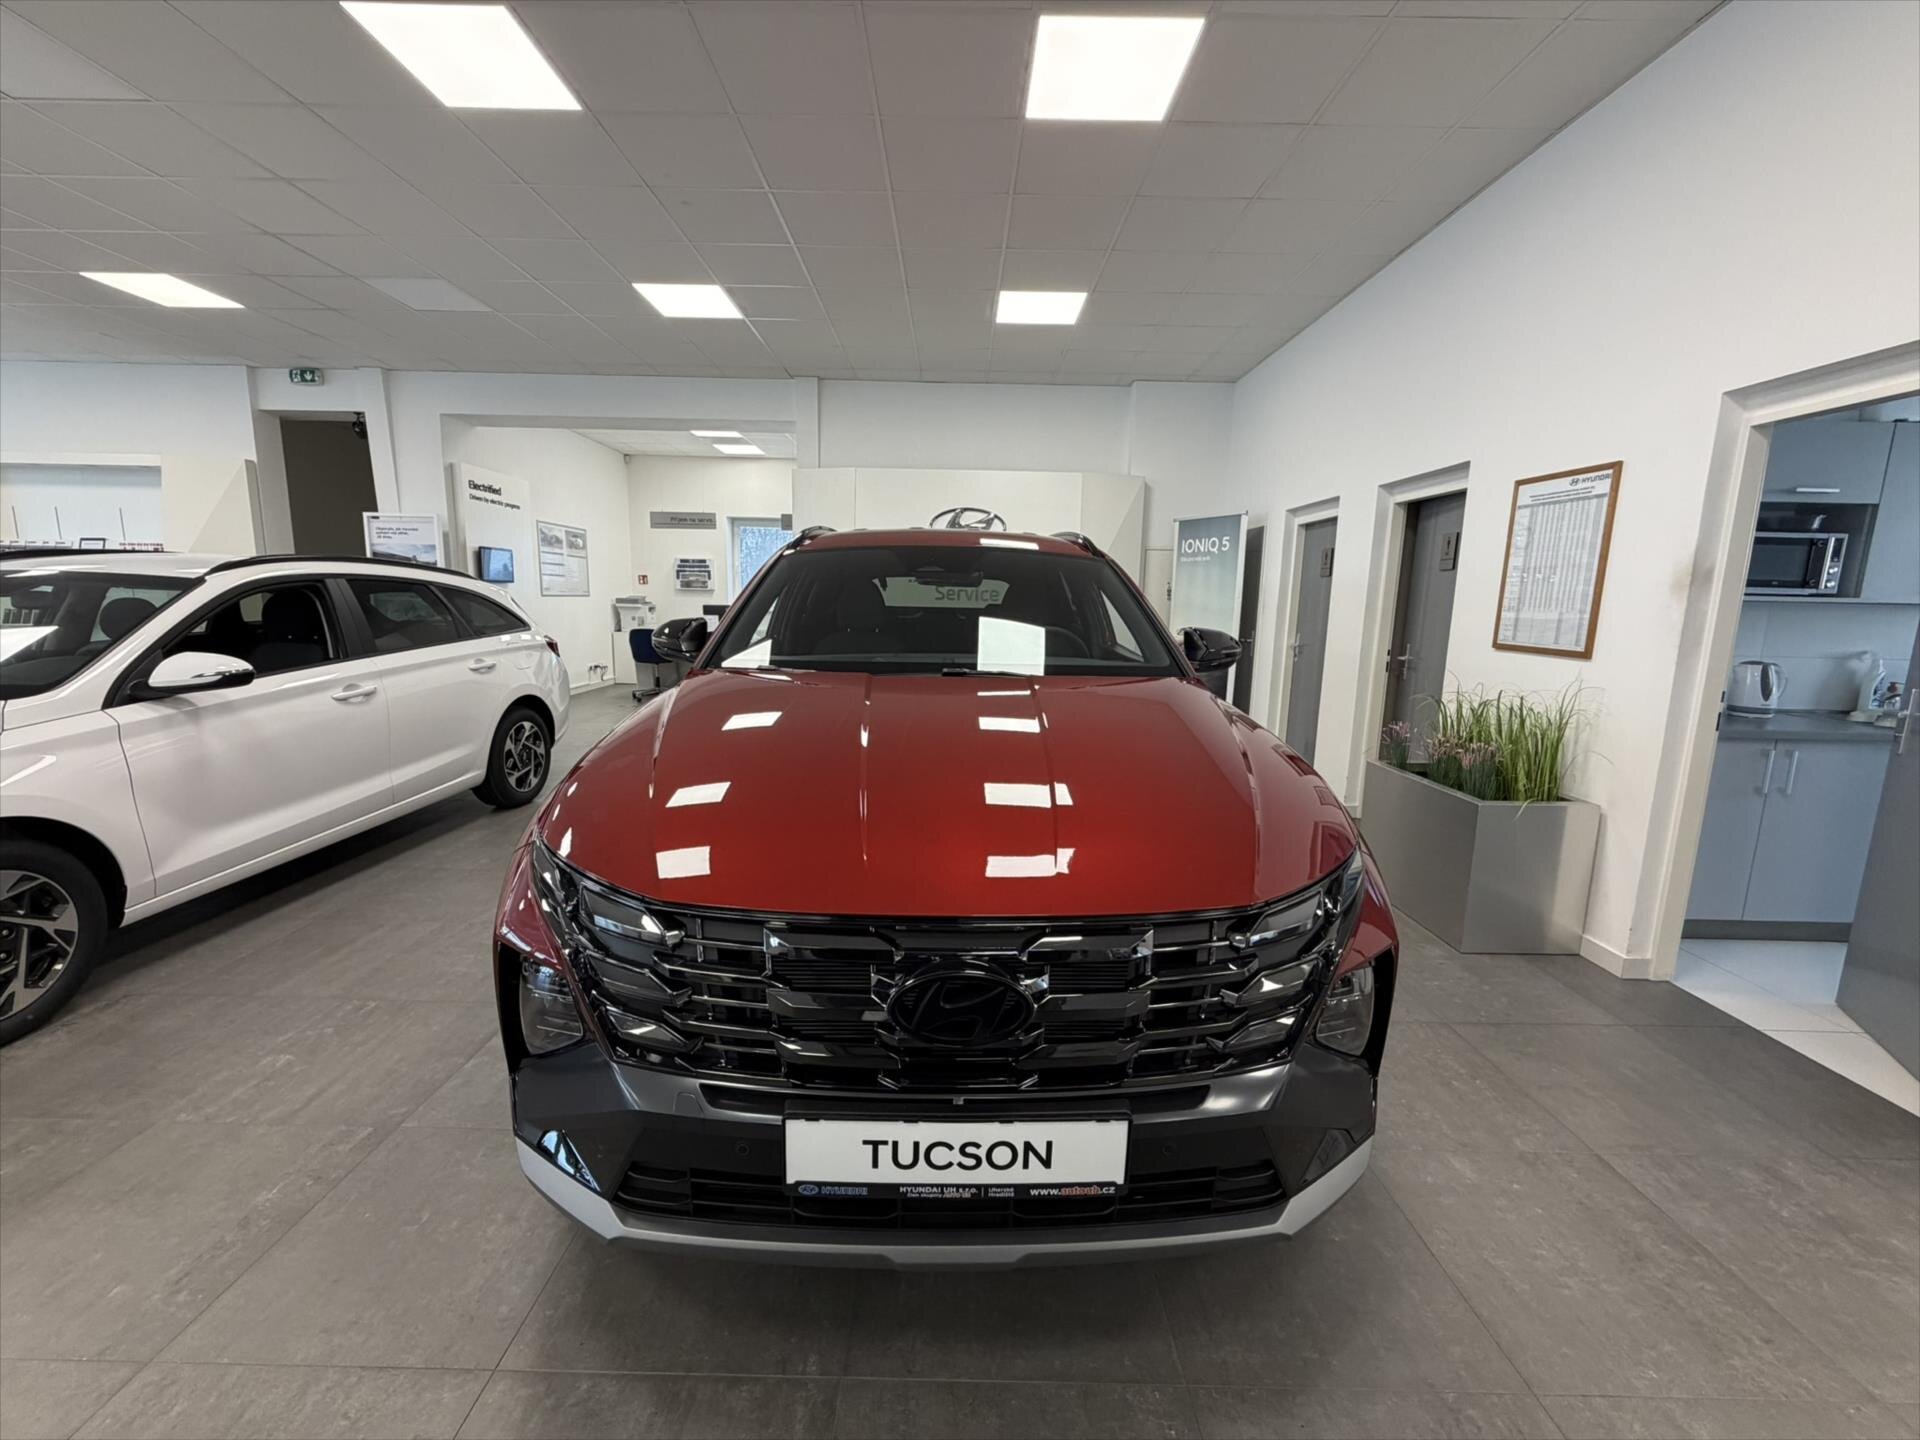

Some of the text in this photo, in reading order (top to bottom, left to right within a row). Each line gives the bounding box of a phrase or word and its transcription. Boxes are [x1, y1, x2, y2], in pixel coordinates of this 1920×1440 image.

[468, 480, 501, 496] Electrified
[1181, 536, 1230, 554] IONIQ 5
[935, 585, 999, 602] Service
[862, 1140, 1053, 1170] TUCSON
[900, 1186, 941, 1194] HYUNDAI
[1030, 1185, 1116, 1196] www.autouh.cz
